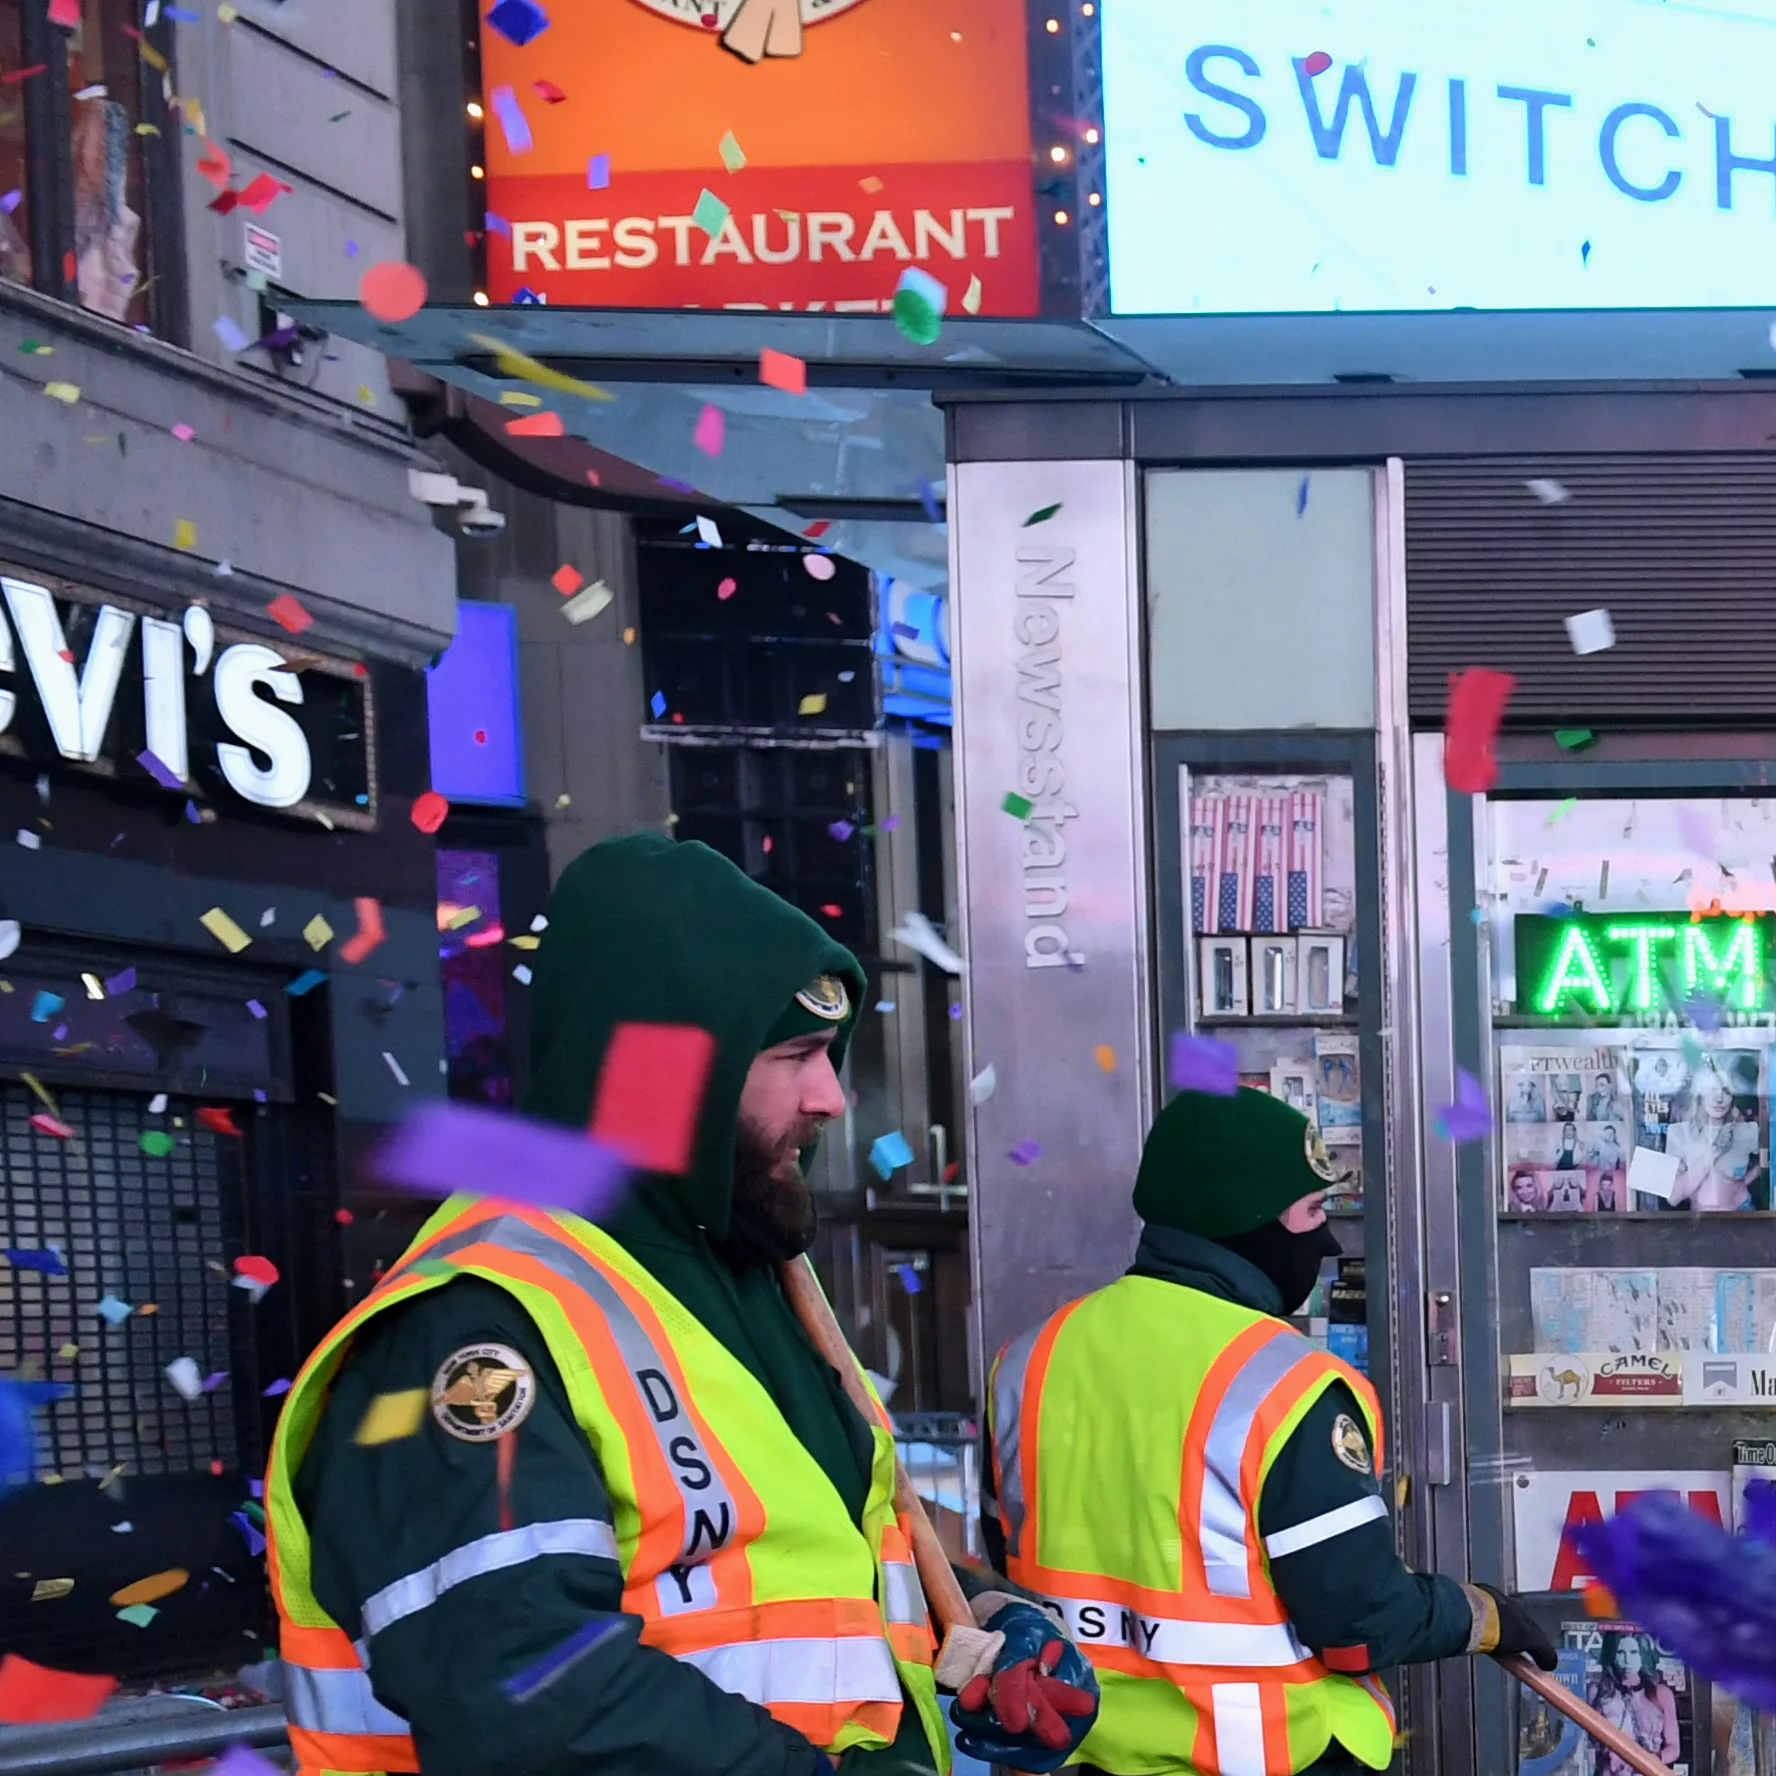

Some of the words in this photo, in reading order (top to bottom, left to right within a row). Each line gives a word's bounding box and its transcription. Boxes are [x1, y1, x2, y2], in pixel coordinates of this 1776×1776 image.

[511, 206, 1014, 273] RESTAURANT
[1014, 547, 1086, 971] Newsstand
[1539, 922, 1764, 1012] ATM
[1600, 1354, 1673, 1378] CAMEL
[636, 1369, 730, 1605] DSNY
